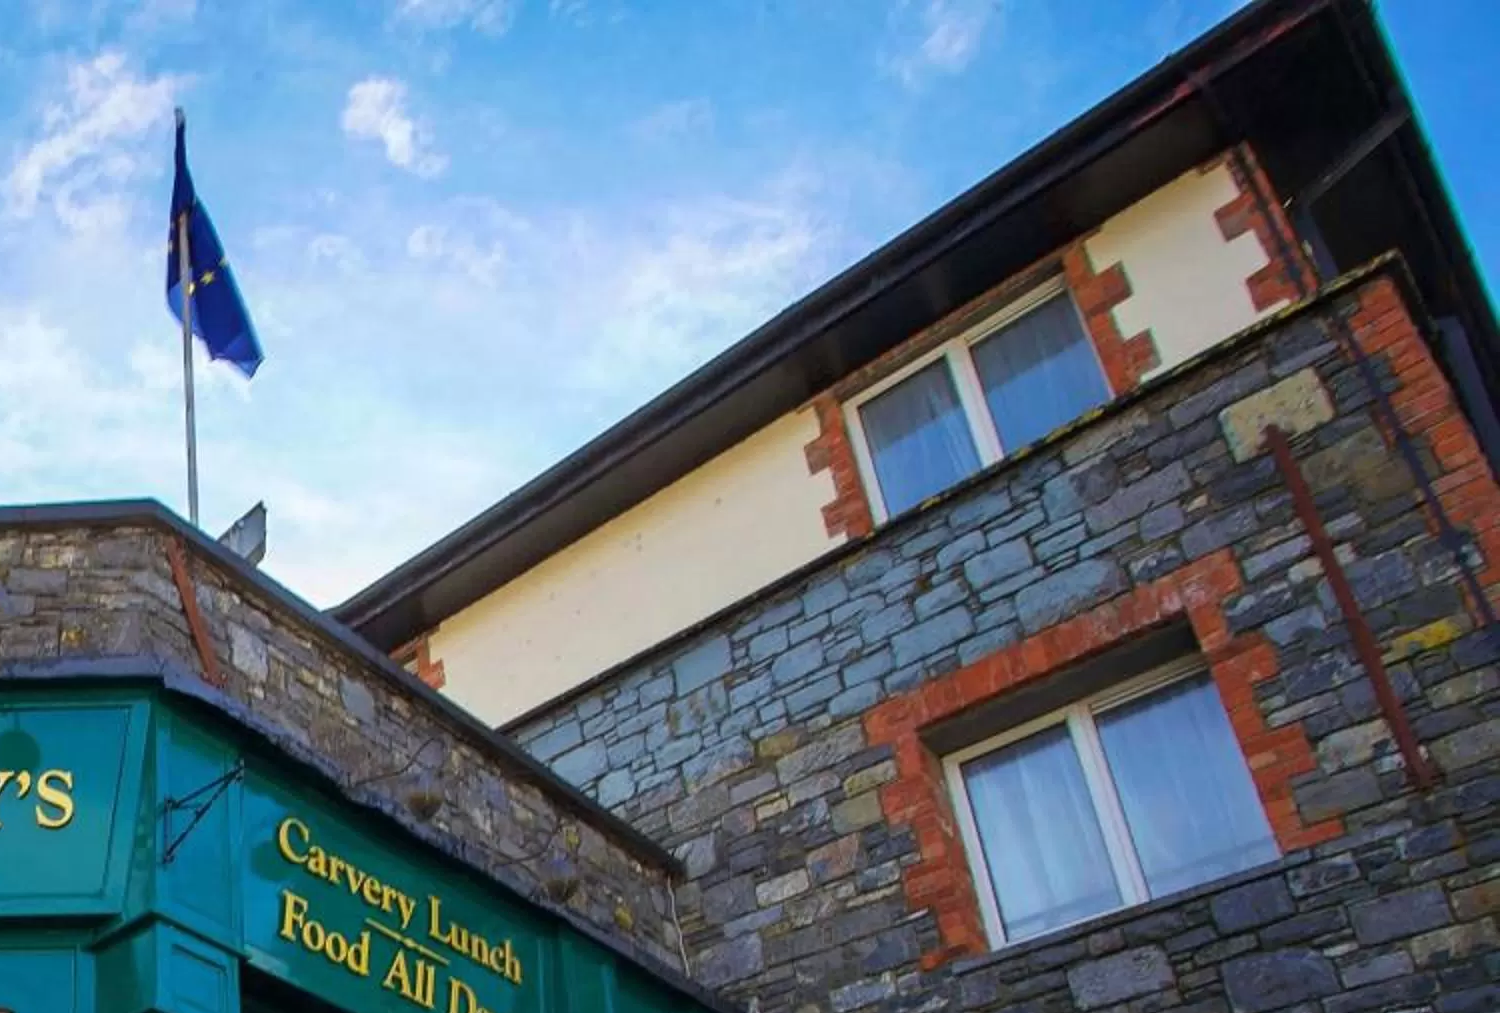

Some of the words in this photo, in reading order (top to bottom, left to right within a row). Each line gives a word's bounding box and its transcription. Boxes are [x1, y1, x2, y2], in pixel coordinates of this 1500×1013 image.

[279, 818, 415, 928] Carvery
[429, 896, 523, 985] Lunch
[281, 890, 371, 976] Food
[384, 951, 435, 1008] All
